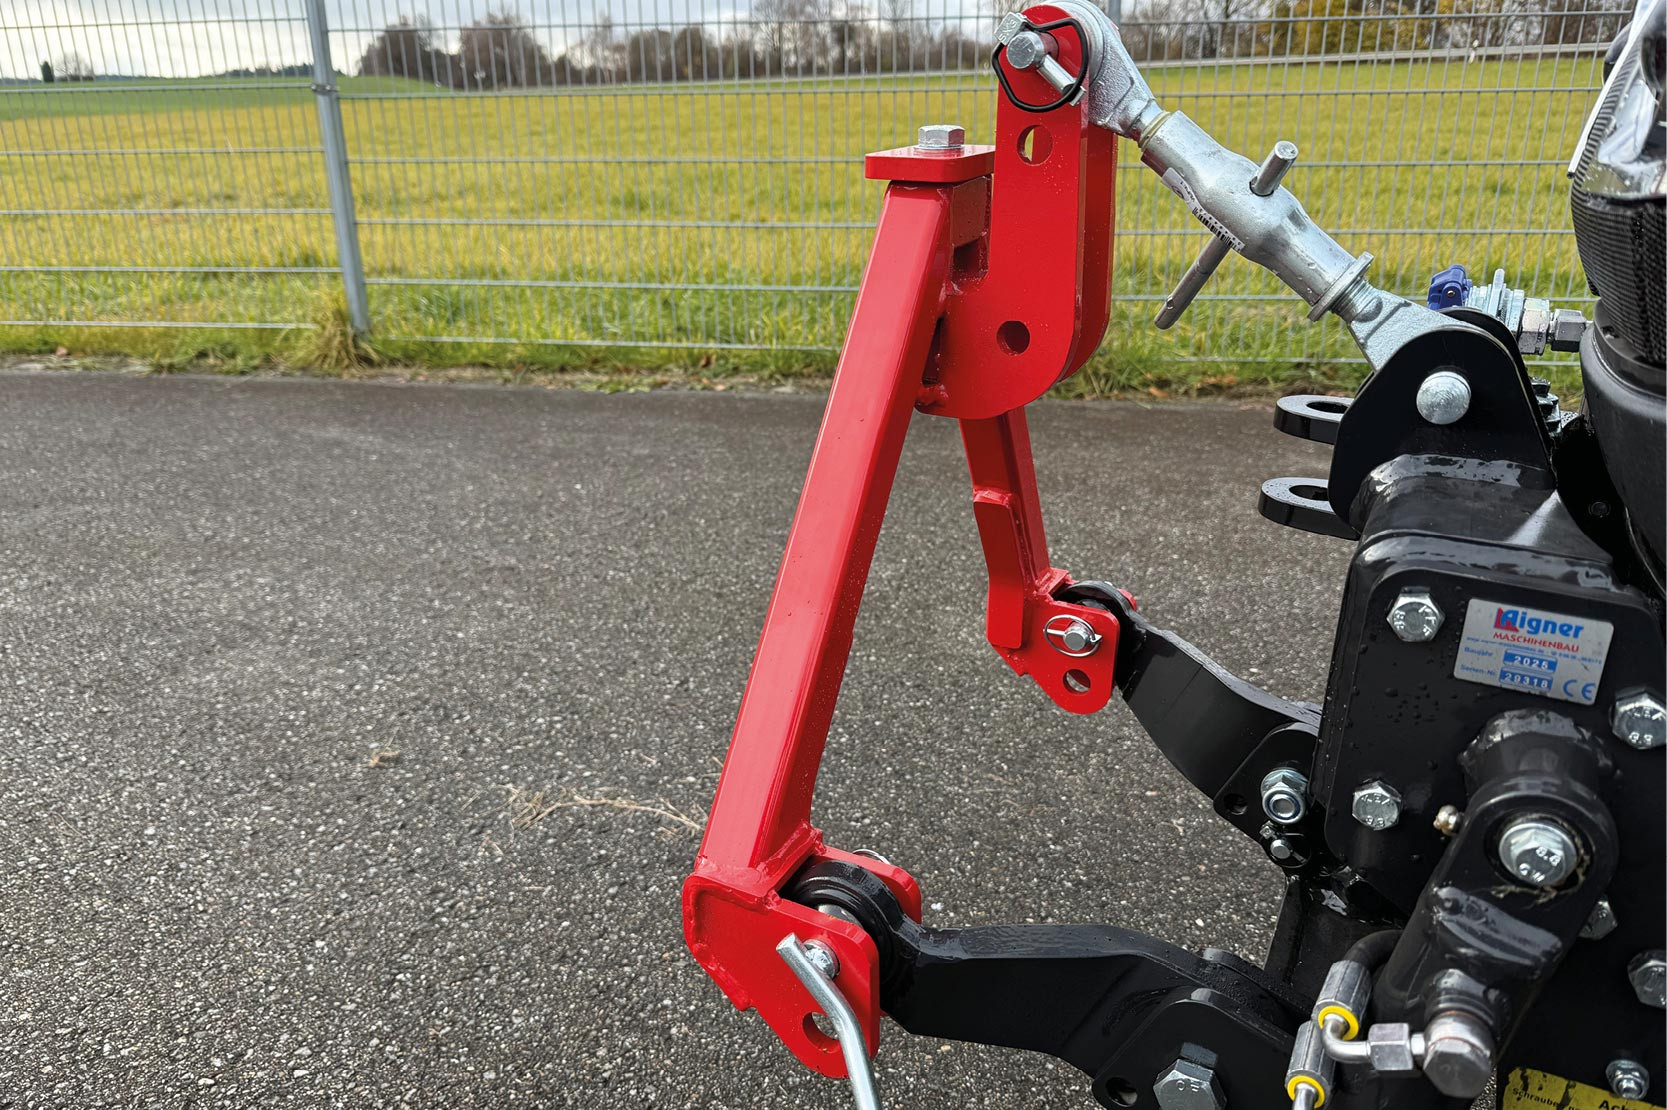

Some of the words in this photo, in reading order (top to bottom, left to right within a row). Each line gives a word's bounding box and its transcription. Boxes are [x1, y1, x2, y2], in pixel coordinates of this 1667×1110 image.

[1495, 607, 1584, 638] Aigner
[1493, 631, 1580, 653] MASCHINENBAU
[1513, 655, 1549, 670] 2025
